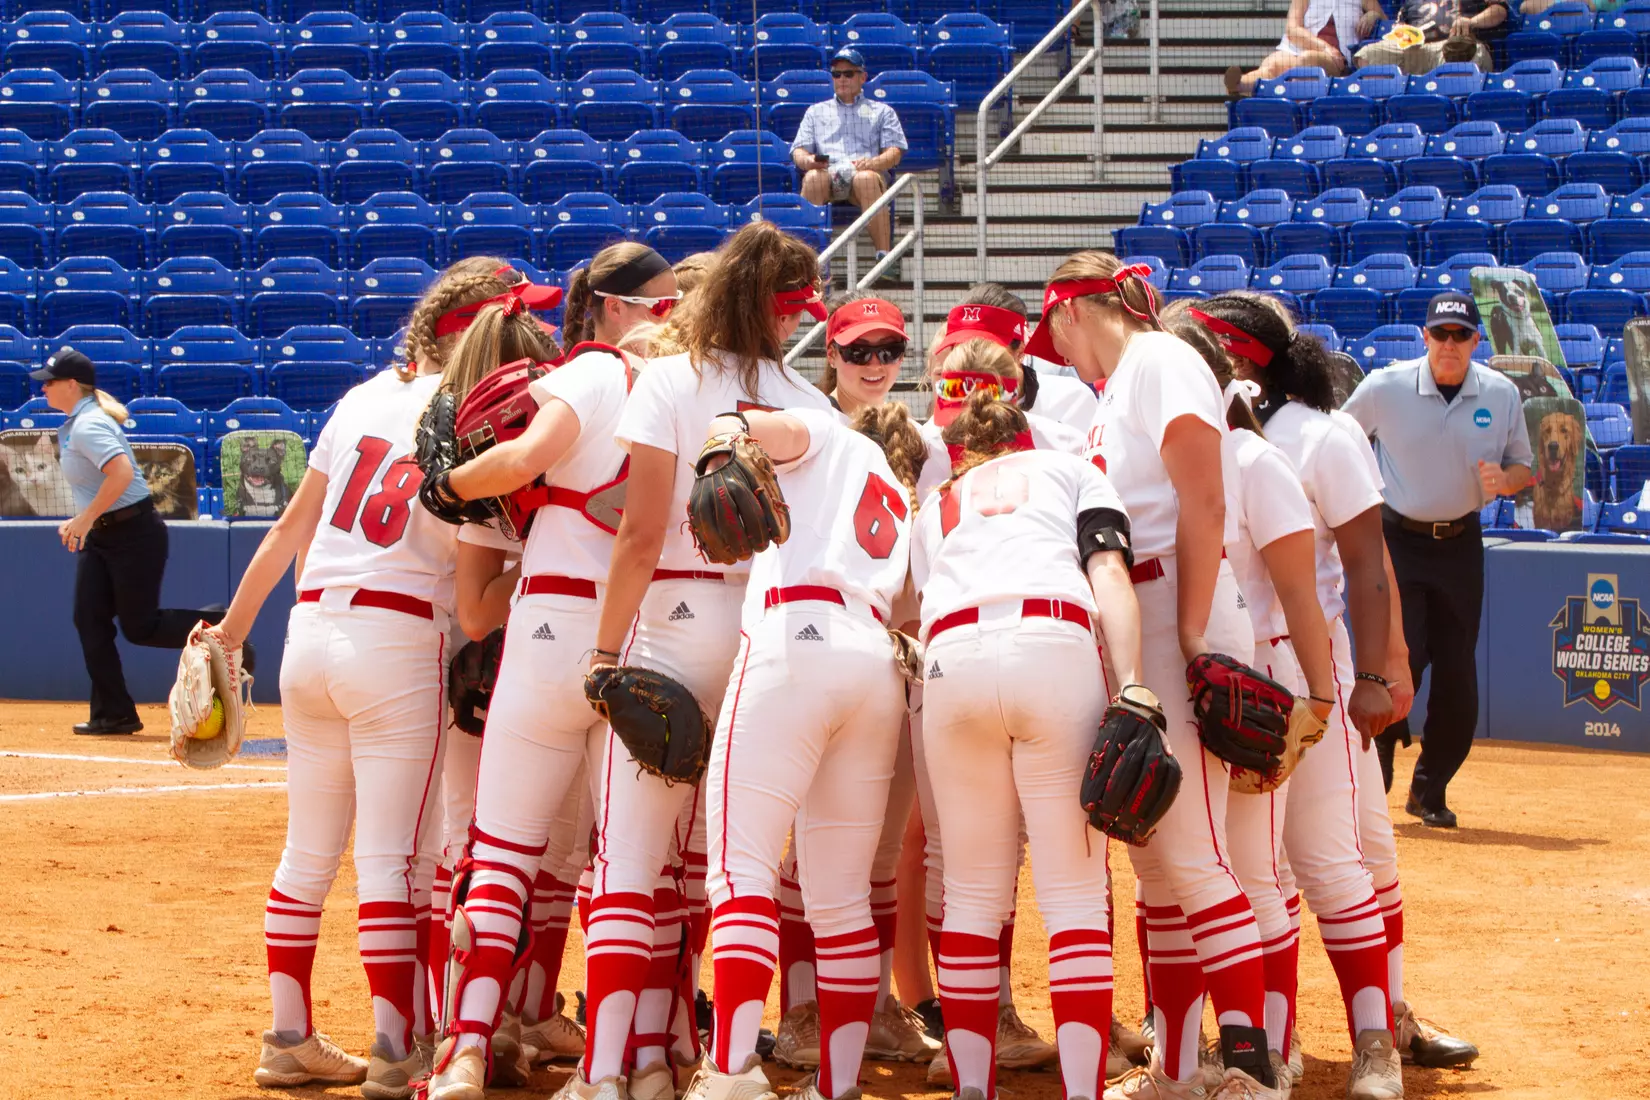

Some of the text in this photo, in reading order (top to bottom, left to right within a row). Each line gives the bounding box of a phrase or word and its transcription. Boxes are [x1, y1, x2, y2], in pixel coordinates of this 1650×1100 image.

[863, 303, 879, 315] M
[962, 307, 981, 321] M
[1435, 301, 1467, 314] NCAA
[330, 435, 425, 548] 18
[853, 472, 908, 559] 6
[1592, 592, 1614, 602] NCAA
[1583, 626, 1623, 634] WOMEN'S
[1575, 633, 1631, 652] COLLEGE
[1556, 651, 1650, 672] WORLD SERIES
[1575, 671, 1631, 680] OKLAHOMA CITY
[1584, 722, 1621, 737] 2014
